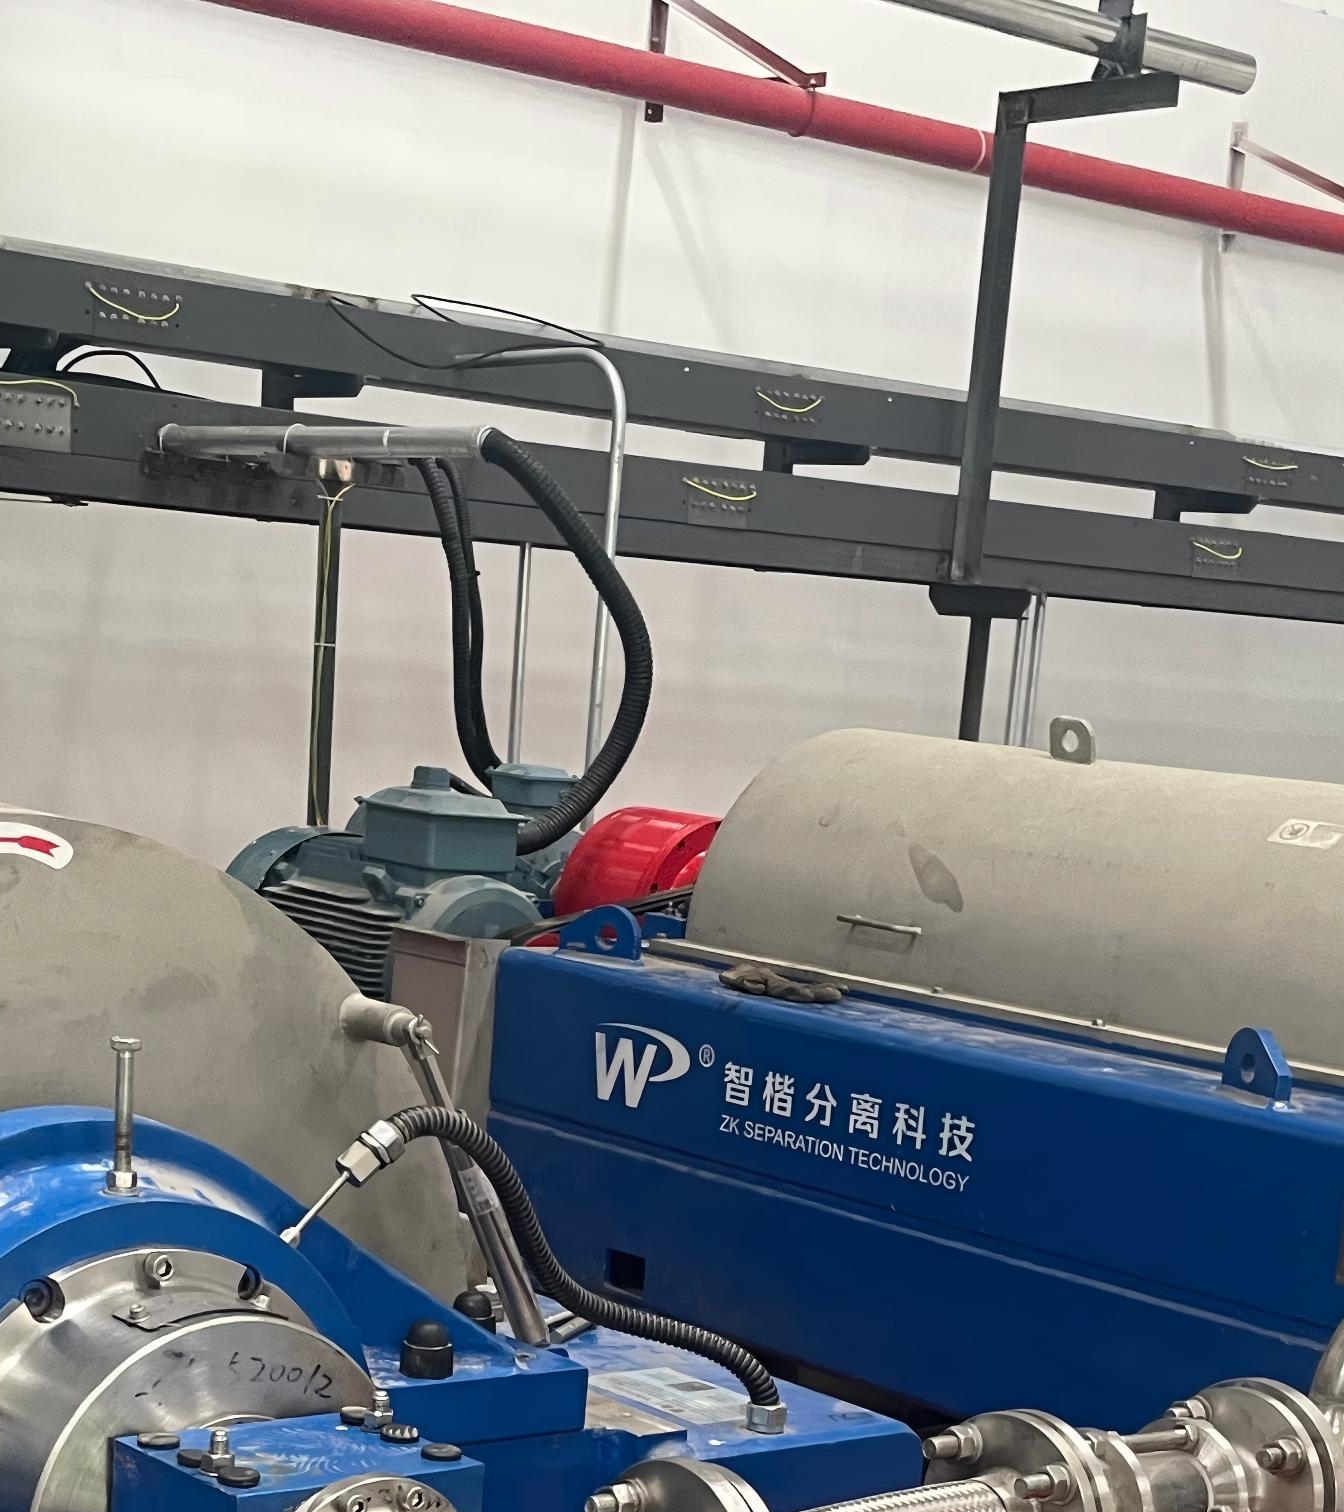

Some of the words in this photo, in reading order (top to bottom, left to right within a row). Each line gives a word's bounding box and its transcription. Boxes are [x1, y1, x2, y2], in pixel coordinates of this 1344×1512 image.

[720, 1115, 740, 1134] ZK
[743, 1121, 844, 1162] SEPARATION
[848, 1147, 970, 1192] TECHNOLOGY
[723, 1061, 976, 1162] 智楷分离科技
